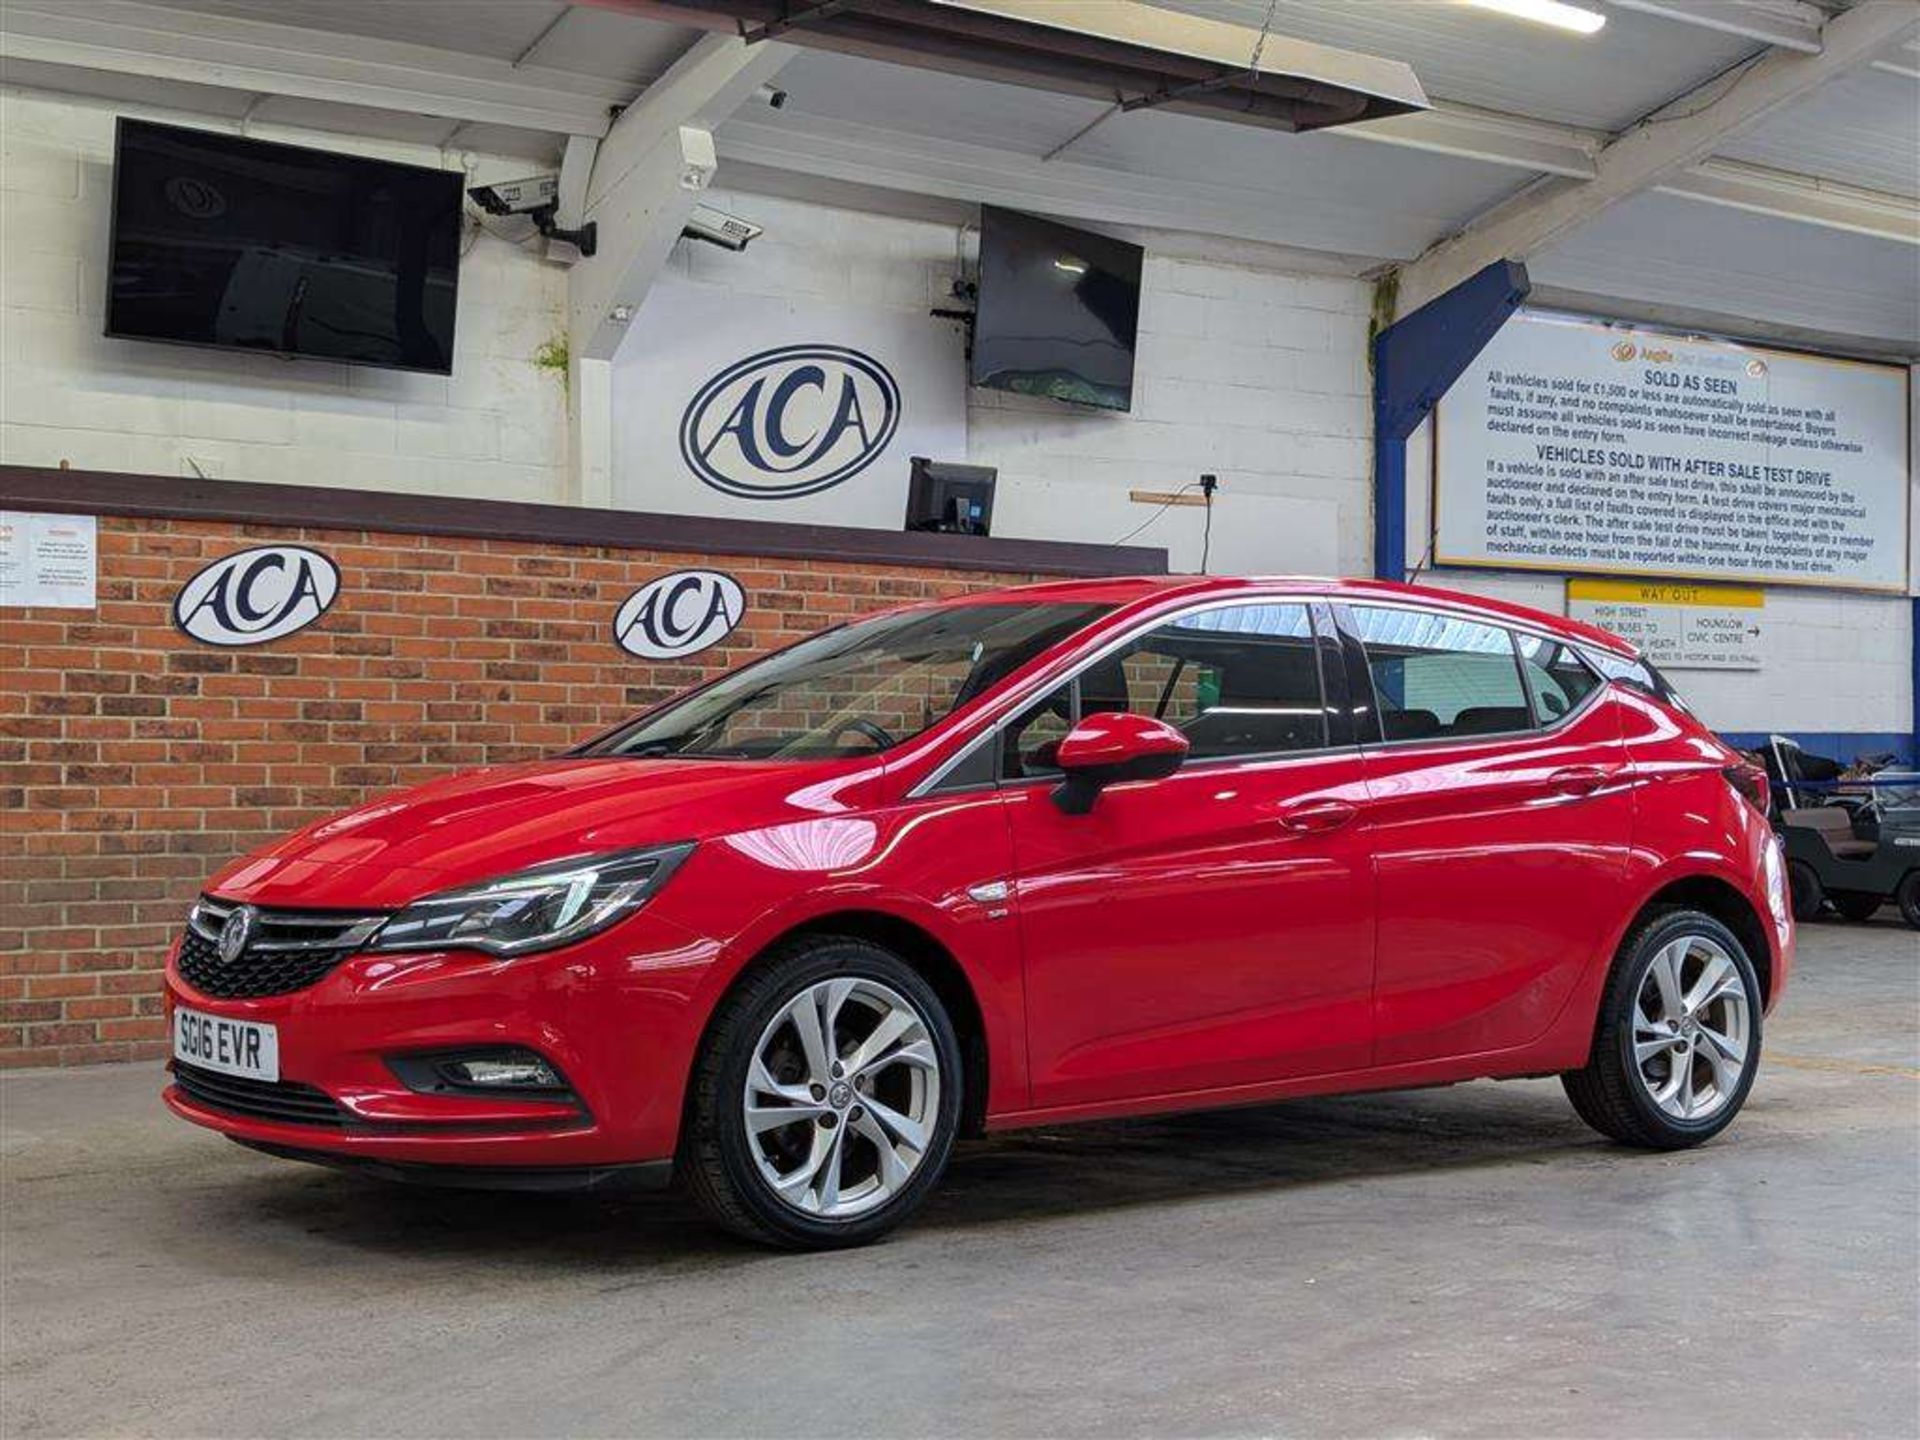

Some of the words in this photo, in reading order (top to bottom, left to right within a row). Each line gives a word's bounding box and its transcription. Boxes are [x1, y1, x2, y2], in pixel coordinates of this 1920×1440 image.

[1487, 371, 1502, 384] All
[1504, 375, 1549, 389] vehicles
[1551, 380, 1574, 392] sold
[1576, 381, 1590, 394] for
[1628, 390, 1640, 400] or
[1642, 389, 1661, 402] less
[1664, 394, 1680, 404] are
[1682, 395, 1743, 414] automatically
[1746, 402, 1766, 414] sold
[1768, 406, 1779, 415] as
[1781, 407, 1803, 418] seen
[1804, 409, 1822, 420] with
[1824, 411, 1835, 422] all
[1645, 370, 1679, 388] SOLD
[1683, 375, 1700, 391] AS
[1704, 380, 1737, 395] SEEN
[702, 366, 871, 473] ACA
[1487, 419, 1534, 434] declared
[1536, 426, 1550, 436] on
[1552, 425, 1569, 438] the
[1572, 428, 1598, 443] entry
[1600, 429, 1626, 443] form.
[1488, 406, 1514, 418] must
[1516, 409, 1558, 422] assume
[1561, 412, 1574, 424] all
[1576, 414, 1618, 428] vehicles
[1620, 419, 1641, 430] sold
[1644, 422, 1655, 432] as
[1658, 424, 1681, 434] seen
[1683, 424, 1705, 437] have
[1708, 426, 1750, 441] incorrect
[1751, 431, 1788, 447] mileage
[1790, 436, 1819, 448] unless
[1820, 438, 1863, 453] otherwise
[1490, 387, 1524, 403] faults,
[1526, 391, 1534, 403] if
[1560, 396, 1579, 408] and
[1582, 399, 1596, 410] no
[1599, 401, 1651, 416] complaints
[1654, 406, 1709, 422] whatsoever
[1711, 412, 1734, 425] shall
[1736, 414, 1747, 427] be
[1805, 422, 1835, 438] Buyers
[1487, 460, 1495, 472] If
[1497, 463, 1504, 472] a
[1506, 463, 1544, 476] vehicle
[1546, 465, 1556, 477] is
[1559, 467, 1581, 479] sold
[1584, 469, 1605, 481] with
[1608, 473, 1621, 482] an
[1623, 472, 1645, 485] after
[1649, 475, 1668, 487] sale
[1670, 476, 1689, 489] test
[1720, 481, 1737, 493] this
[1740, 483, 1762, 495] shall
[1764, 485, 1776, 496] be
[1778, 488, 1826, 501] announced
[1828, 490, 1839, 504] by
[1841, 491, 1855, 503] the
[1536, 445, 1604, 465] VEHICLES
[1609, 452, 1644, 469] SOLD
[1648, 455, 1681, 472] WITH
[1685, 459, 1725, 476] AFTER
[1729, 463, 1760, 480] SALE
[1764, 467, 1793, 483] TEST
[1797, 470, 1831, 486] DRIVE
[1487, 478, 1542, 492] auctioneer
[1545, 483, 1565, 494] and
[1567, 483, 1613, 497] declared
[1615, 489, 1627, 499] on
[1629, 488, 1645, 500] the
[1648, 491, 1672, 505] entry
[1674, 492, 1699, 505] form.
[1702, 494, 1709, 505] A
[1711, 495, 1729, 507] test
[1731, 497, 1755, 509] drive
[1757, 501, 1788, 512] covers
[1790, 503, 1815, 516] major
[1817, 505, 1866, 519] mechanical
[1487, 493, 1516, 505] faults
[1546, 500, 1553, 508] a
[1555, 498, 1572, 510] full
[1574, 499, 1591, 511] list
[1593, 501, 1604, 512] of
[1607, 502, 1634, 515] faults
[1636, 507, 1675, 518] covered
[1678, 508, 1687, 519] is
[1688, 509, 1735, 524] displayed
[1736, 512, 1746, 523] in
[1747, 513, 1763, 525] the
[1764, 515, 1790, 527] office
[1792, 517, 1809, 528] and
[1811, 518, 1829, 530] with
[1831, 520, 1845, 531] the
[1486, 525, 1498, 536] of
[1529, 528, 1562, 541] within
[1564, 532, 1583, 542] one
[1586, 532, 1610, 544] hour
[1612, 533, 1635, 545] from
[1637, 535, 1652, 546] the
[1655, 536, 1670, 548] fall
[1672, 537, 1683, 548] of
[1684, 538, 1700, 550] the
[1744, 542, 1762, 556] Any
[1764, 545, 1813, 558] complaints
[1815, 547, 1825, 558] of
[1826, 549, 1841, 561] any
[1843, 549, 1868, 563] major
[1585, 516, 1604, 528] The
[1606, 518, 1629, 530] after
[1632, 520, 1651, 531] sale
[1655, 521, 1672, 533] test
[1675, 523, 1699, 535] drive
[1702, 526, 1725, 537] must
[1727, 526, 1739, 538] be
[1772, 529, 1810, 544] together
[1812, 533, 1830, 544] with
[1832, 536, 1838, 545] a
[1839, 536, 1874, 547] member
[1486, 543, 1547, 556] mechanical
[1550, 545, 1588, 558] defects
[1590, 549, 1616, 560] must
[1618, 549, 1630, 560] be
[1633, 551, 1675, 564] reported
[1677, 553, 1706, 565] within
[1708, 557, 1725, 566] one
[1728, 556, 1749, 567] hour
[1751, 557, 1772, 569] from
[1775, 558, 1789, 570] the
[1792, 559, 1808, 571] test
[183, 553, 325, 635] ACA
[619, 577, 732, 649] ACA
[1595, 607, 1615, 616] HIGH
[1621, 608, 1648, 618] STREET
[1640, 587, 1666, 601] WAY
[1672, 588, 1698, 601] OUT
[1618, 622, 1643, 632] BUSES
[1646, 623, 1658, 633] TO
[1688, 634, 1709, 643] CIVIC
[1714, 634, 1743, 643] CENTRE
[1697, 618, 1742, 628] HOUNSLOW
[1650, 640, 1676, 649] HEATH
[181, 1013, 212, 1060] SG16
[218, 1023, 260, 1069] EVR
